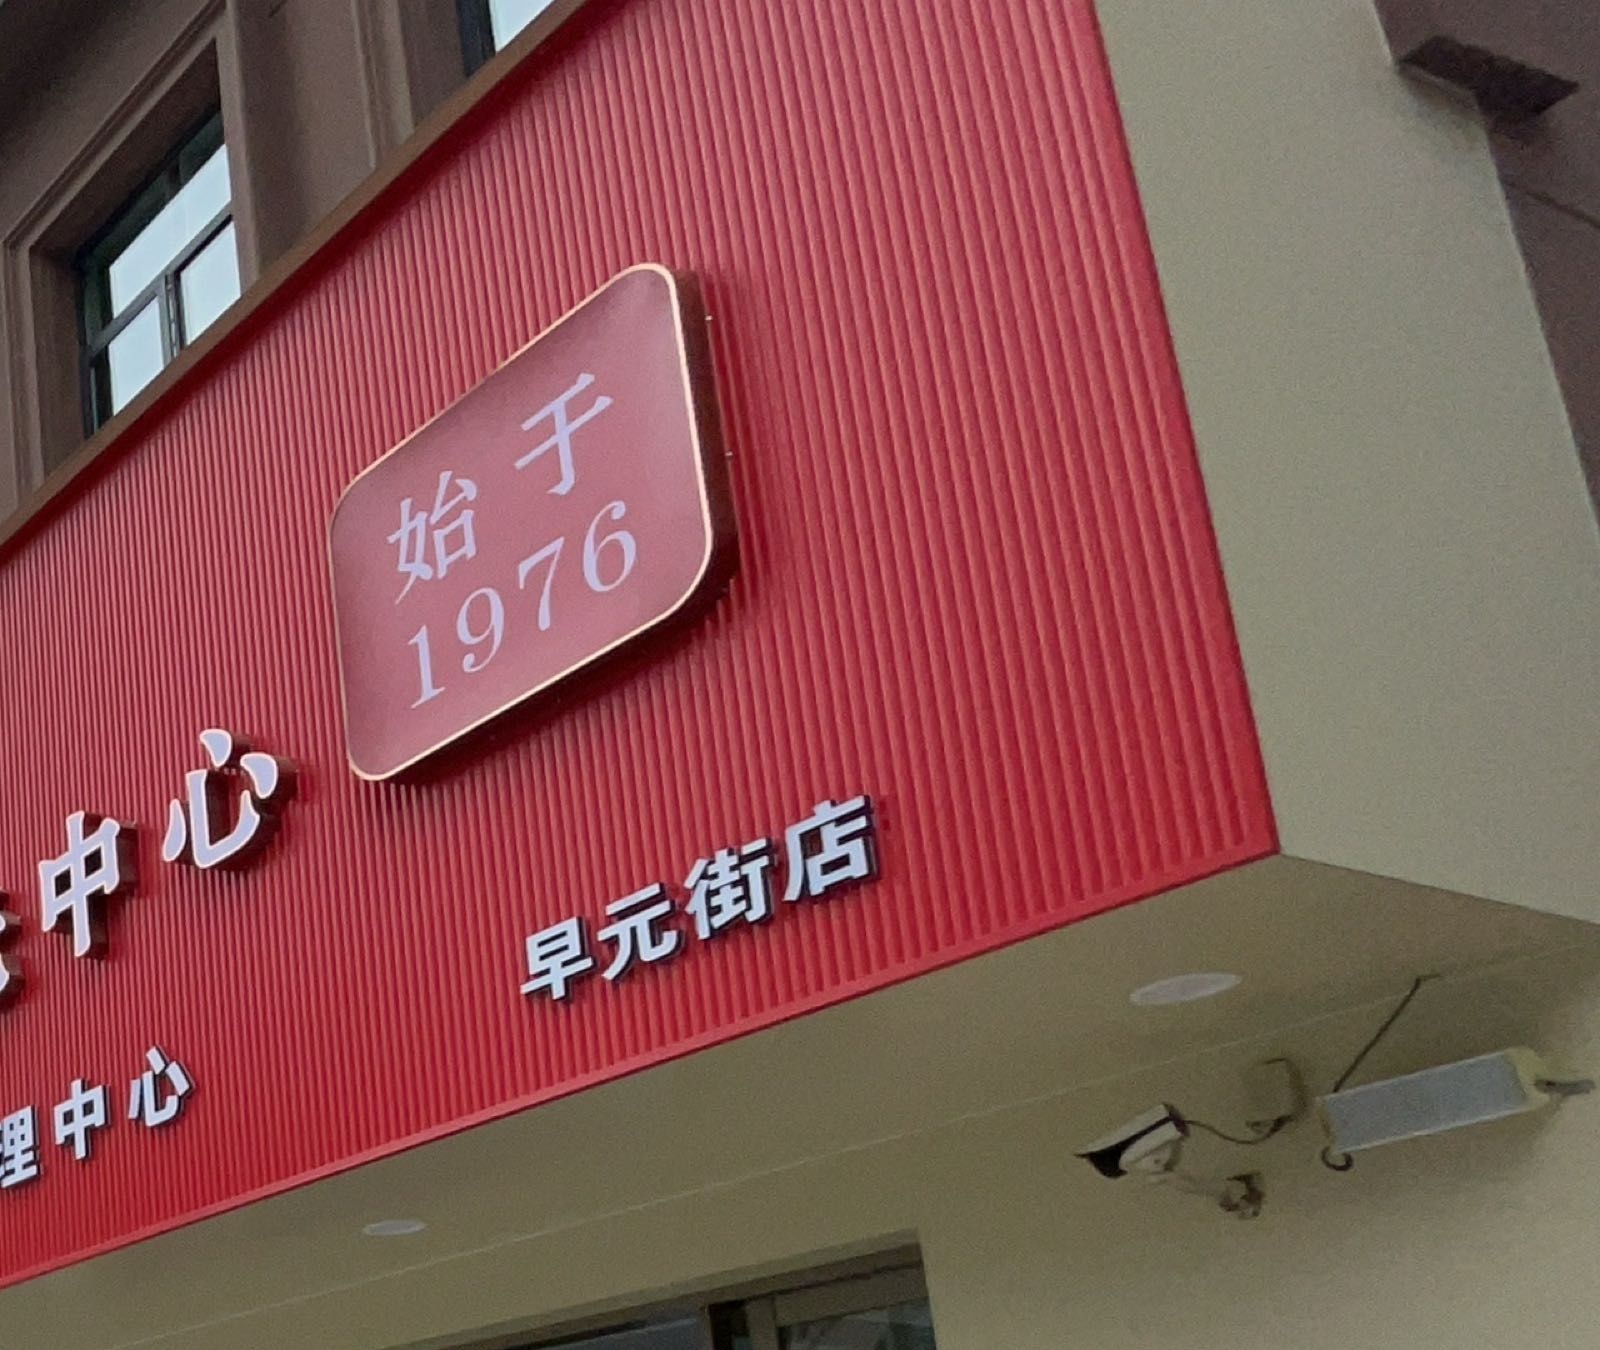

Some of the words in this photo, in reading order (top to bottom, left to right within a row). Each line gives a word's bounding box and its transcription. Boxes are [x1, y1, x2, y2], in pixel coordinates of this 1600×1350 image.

[388, 374, 613, 604] 始于
[408, 501, 637, 708] 1976
[520, 796, 876, 1002] 早元街店
